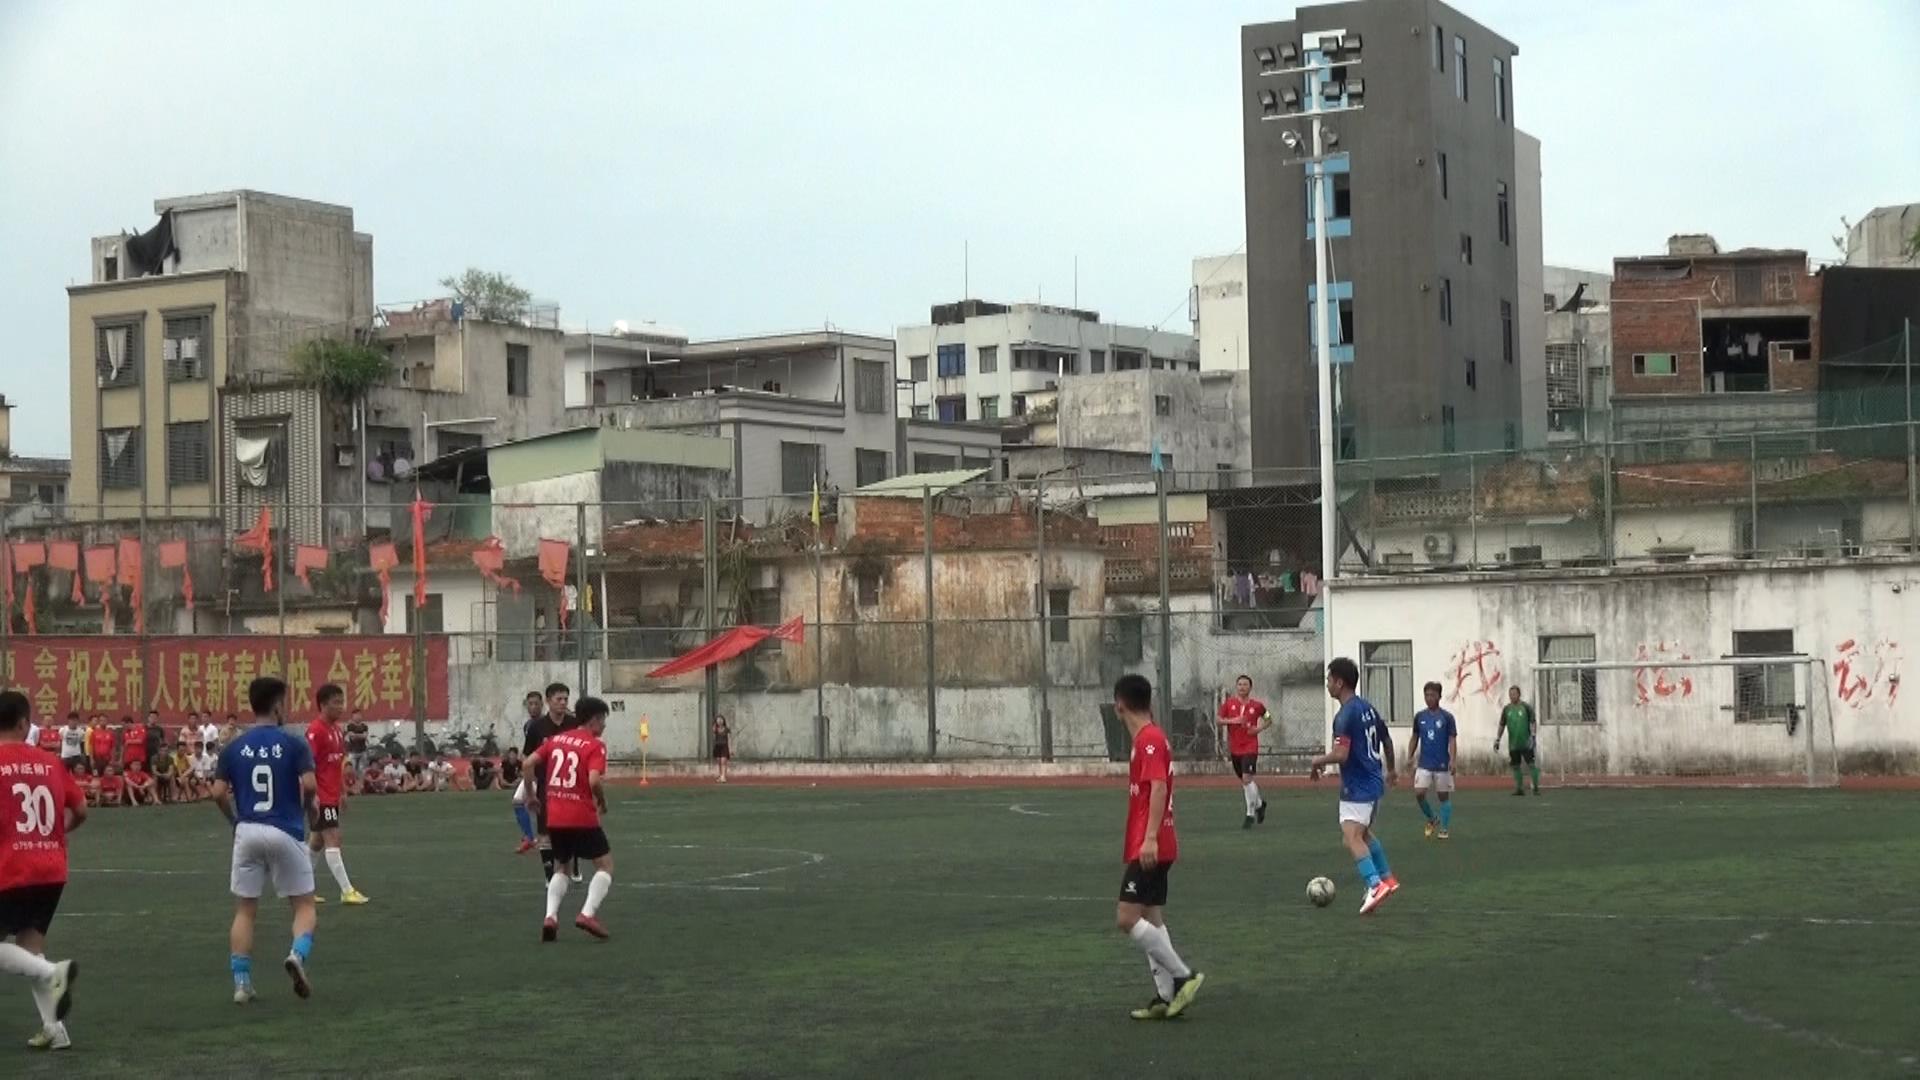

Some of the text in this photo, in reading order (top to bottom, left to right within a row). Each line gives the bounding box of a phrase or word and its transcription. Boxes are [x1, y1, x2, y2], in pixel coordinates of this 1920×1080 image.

[1364, 725, 1381, 760] 10
[251, 764, 273, 812] 9
[548, 748, 579, 789] 23
[12, 782, 55, 836] 30
